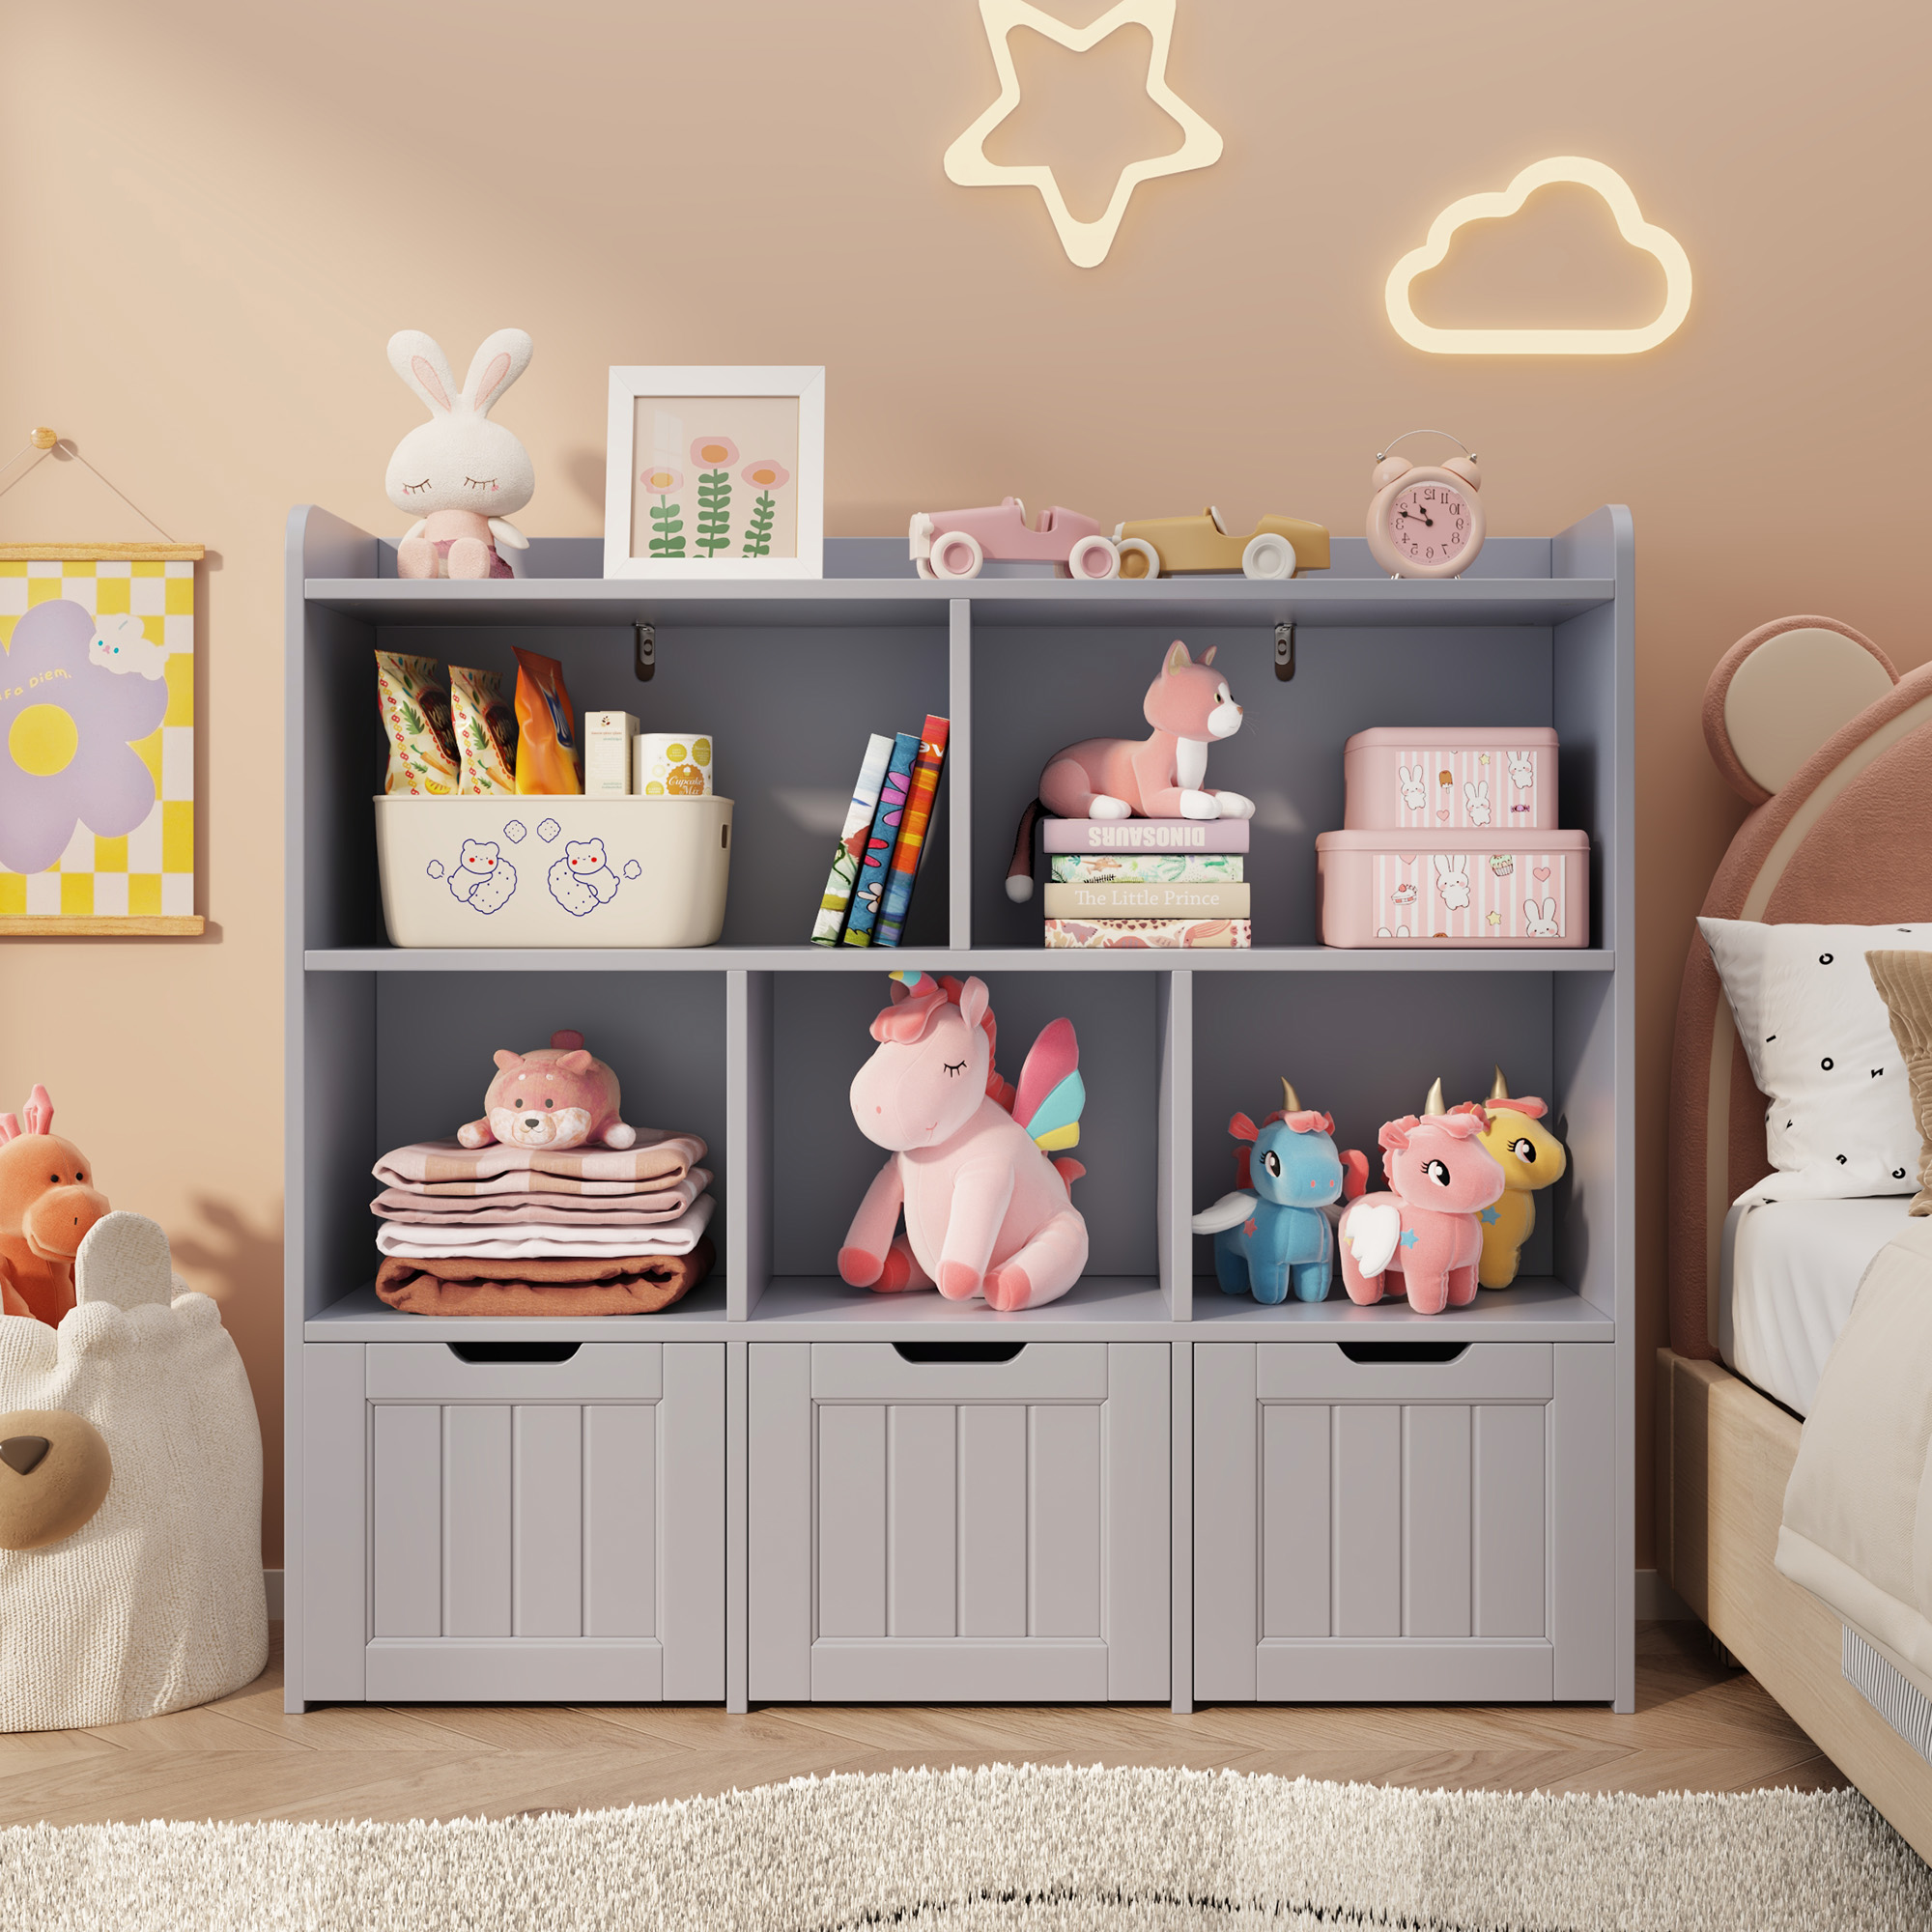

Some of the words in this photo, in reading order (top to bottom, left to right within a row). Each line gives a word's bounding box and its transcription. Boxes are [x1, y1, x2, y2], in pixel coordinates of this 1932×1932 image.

[668, 776, 703, 786] Cupcake
[1089, 826, 1206, 847] DINOSAURS
[1074, 890, 1106, 905] The
[1111, 890, 1158, 905] Little
[1164, 890, 1220, 905] Prince
